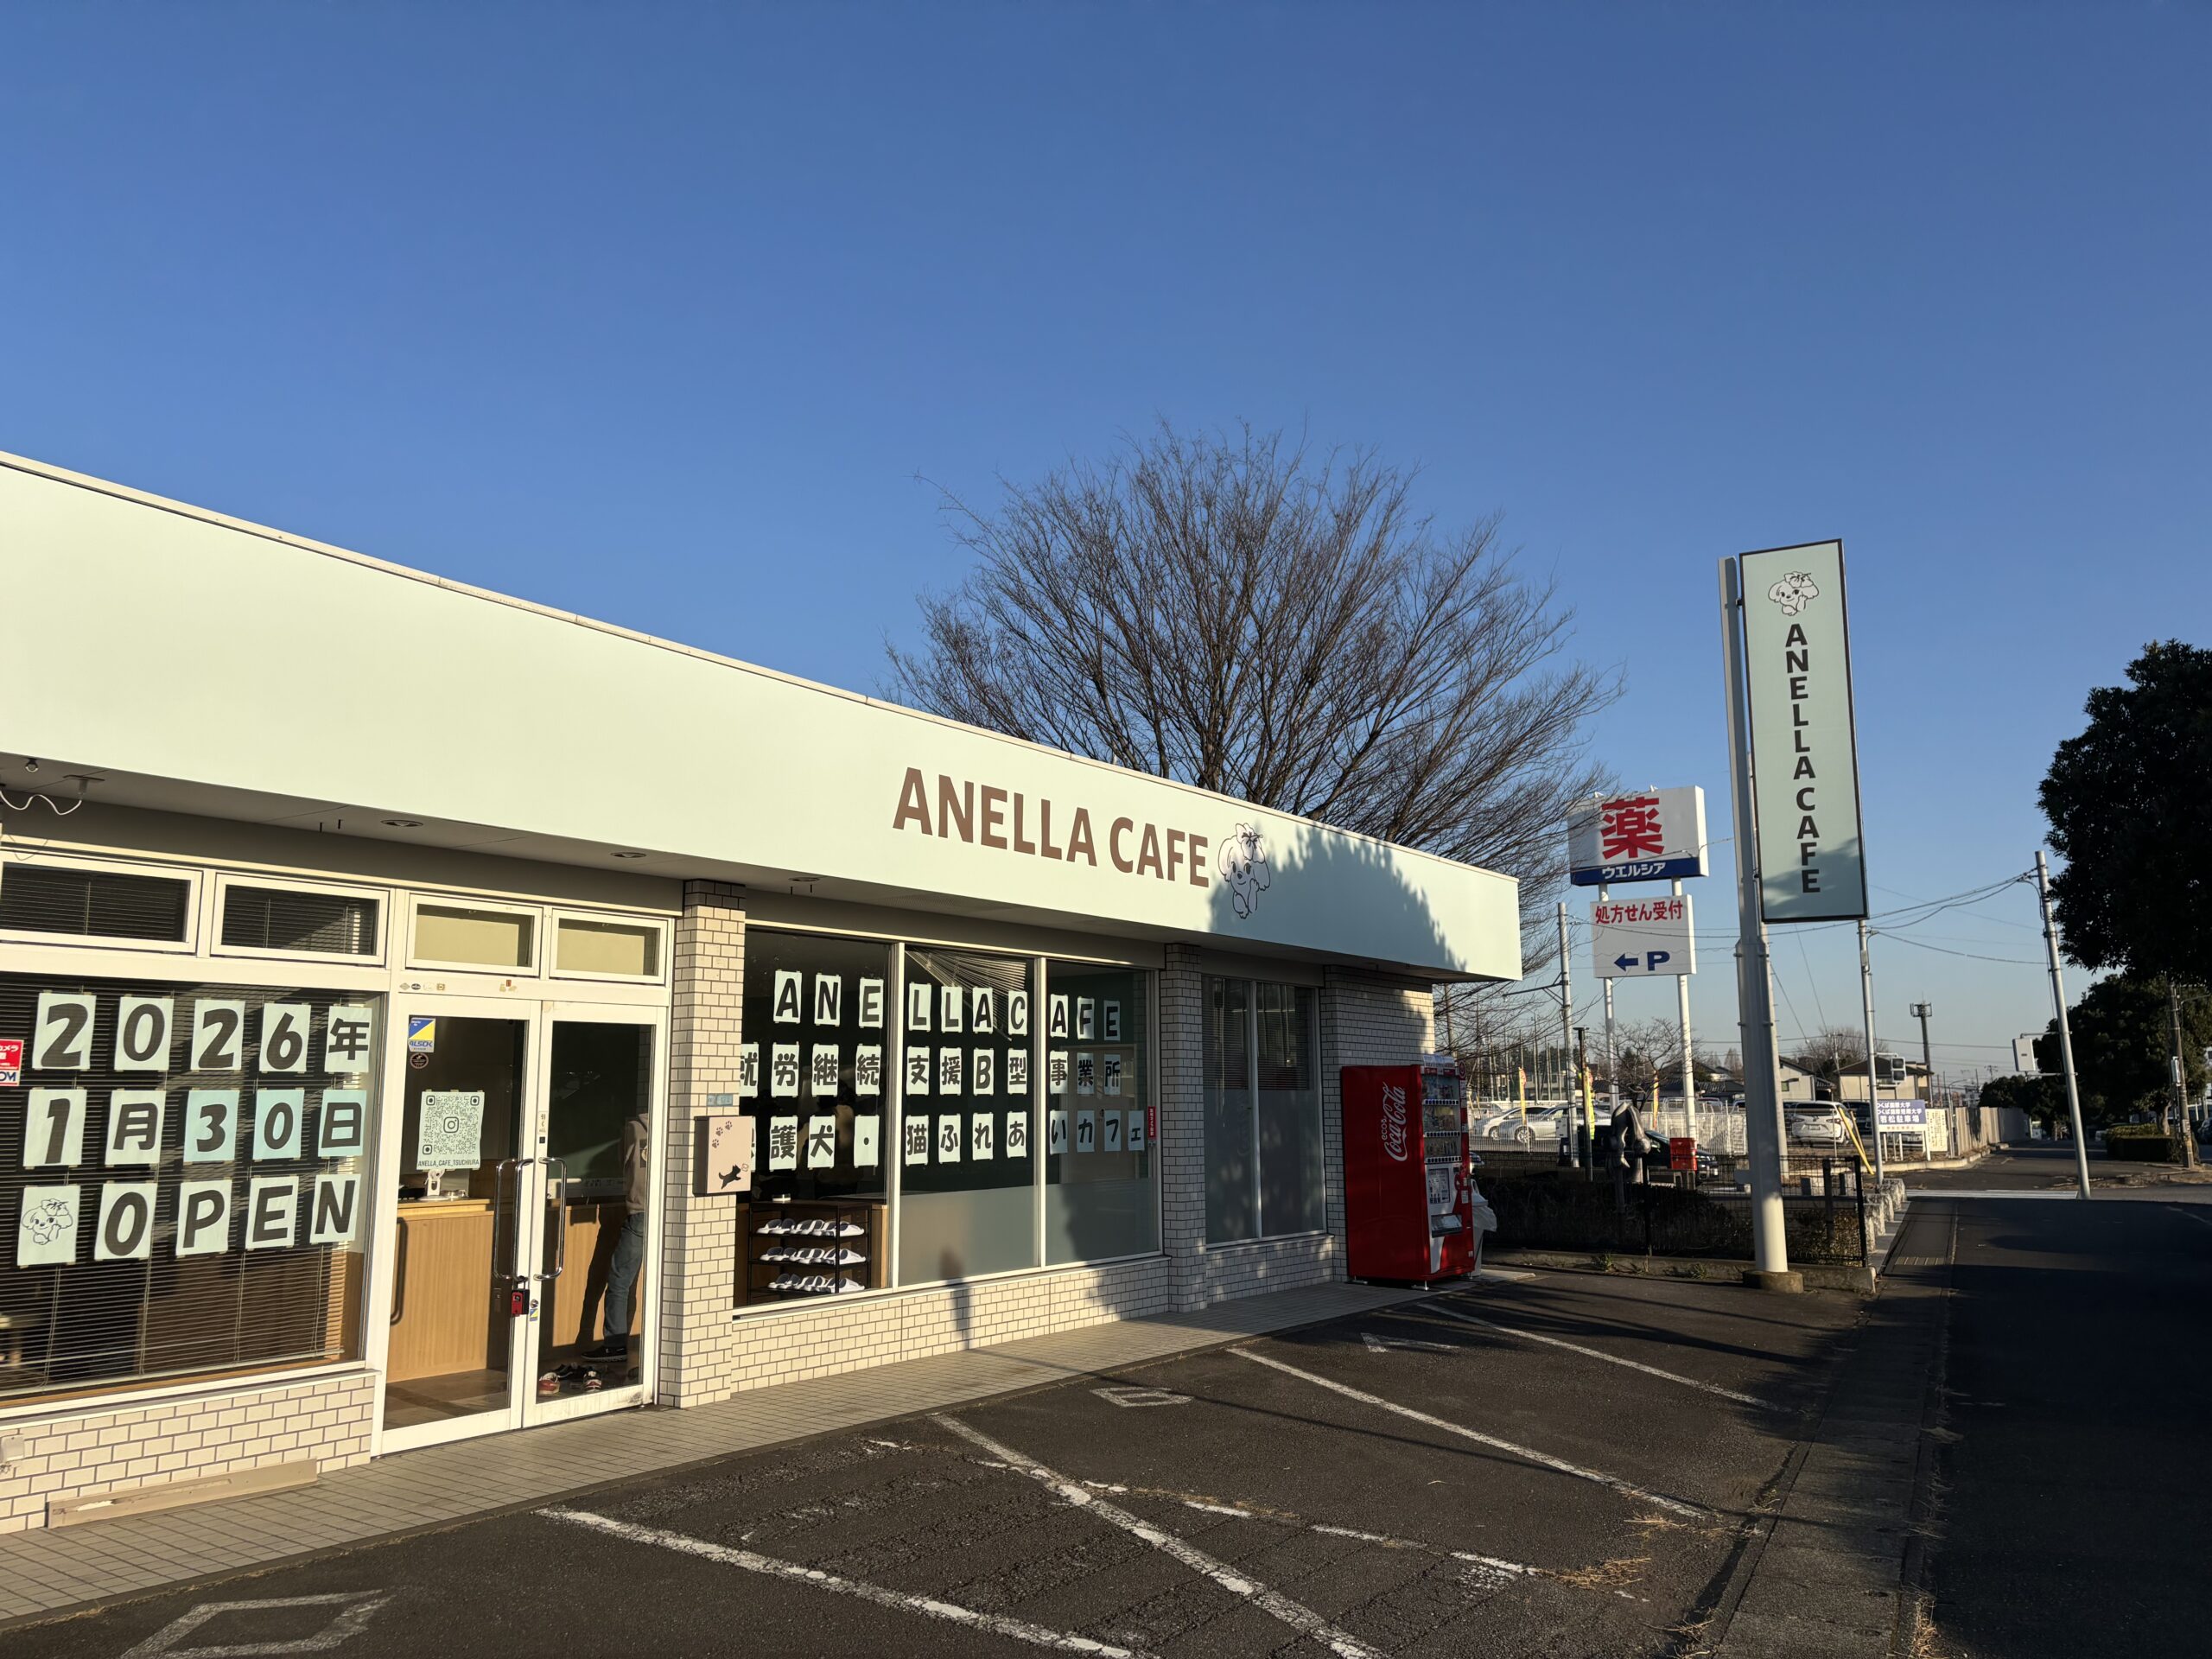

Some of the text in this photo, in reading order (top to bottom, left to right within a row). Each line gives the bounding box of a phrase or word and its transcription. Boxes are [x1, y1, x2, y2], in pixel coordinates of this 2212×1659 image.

[1785, 623, 1821, 893] ANELLA CAFE
[893, 766, 1209, 888] ANELLA CAFE
[1600, 796, 1665, 860] 薬
[1601, 861, 1666, 880] ウエルシア
[1595, 899, 1683, 925] 処方せん受付
[1647, 950, 1671, 971] P
[41, 1002, 371, 1071] 2026年
[741, 1051, 1122, 1089] 就労継続支援B型事業所
[44, 1097, 363, 1165] 1月30日
[751, 1117, 1142, 1161] 護犬・猫ふれあいカフェ
[1382, 1081, 1408, 1161] Coca-Cola
[105, 1179, 355, 1256] OPEN
